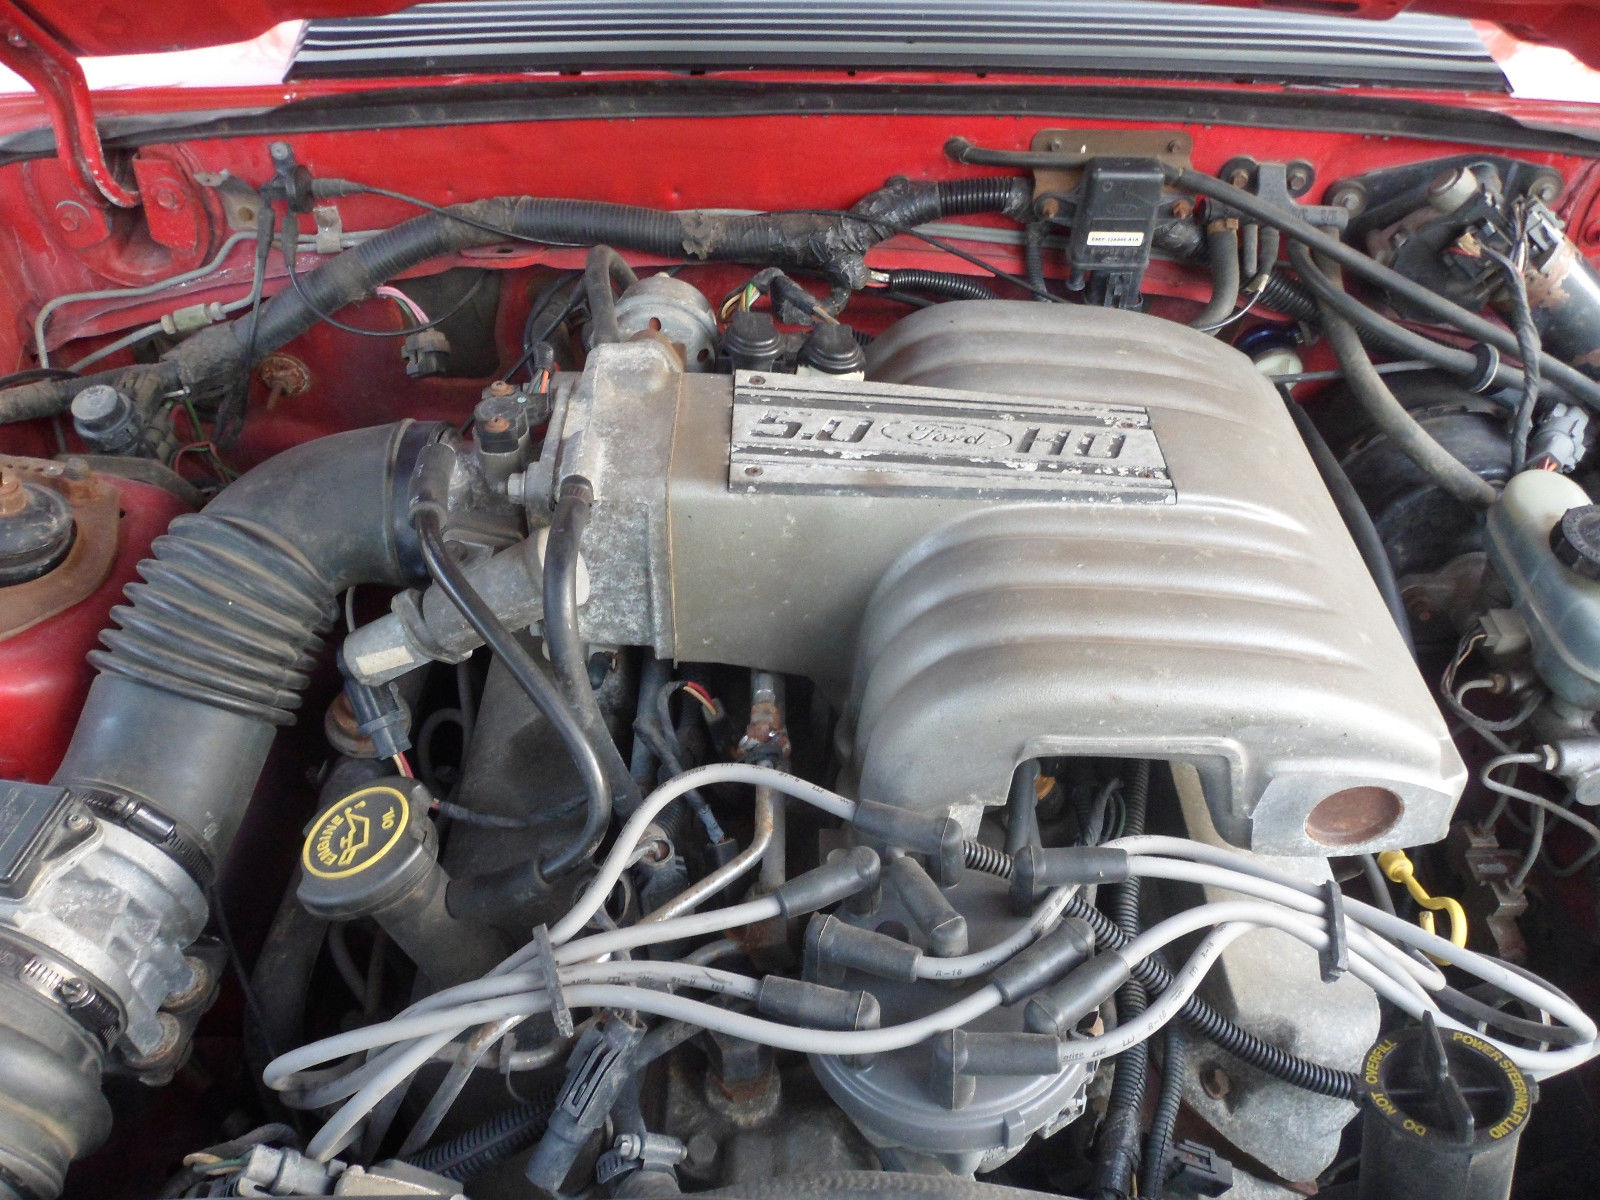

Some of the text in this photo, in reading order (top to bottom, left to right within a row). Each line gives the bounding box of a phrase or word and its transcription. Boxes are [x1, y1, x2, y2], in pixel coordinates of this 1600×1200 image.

[751, 410, 874, 444] 5.0
[908, 422, 985, 447] Ford
[316, 805, 396, 867] ENGINE OIL
[1365, 1039, 1428, 1138] DO NOT OVERFILL
[1452, 1031, 1529, 1140] POWER STEERING FLUID
